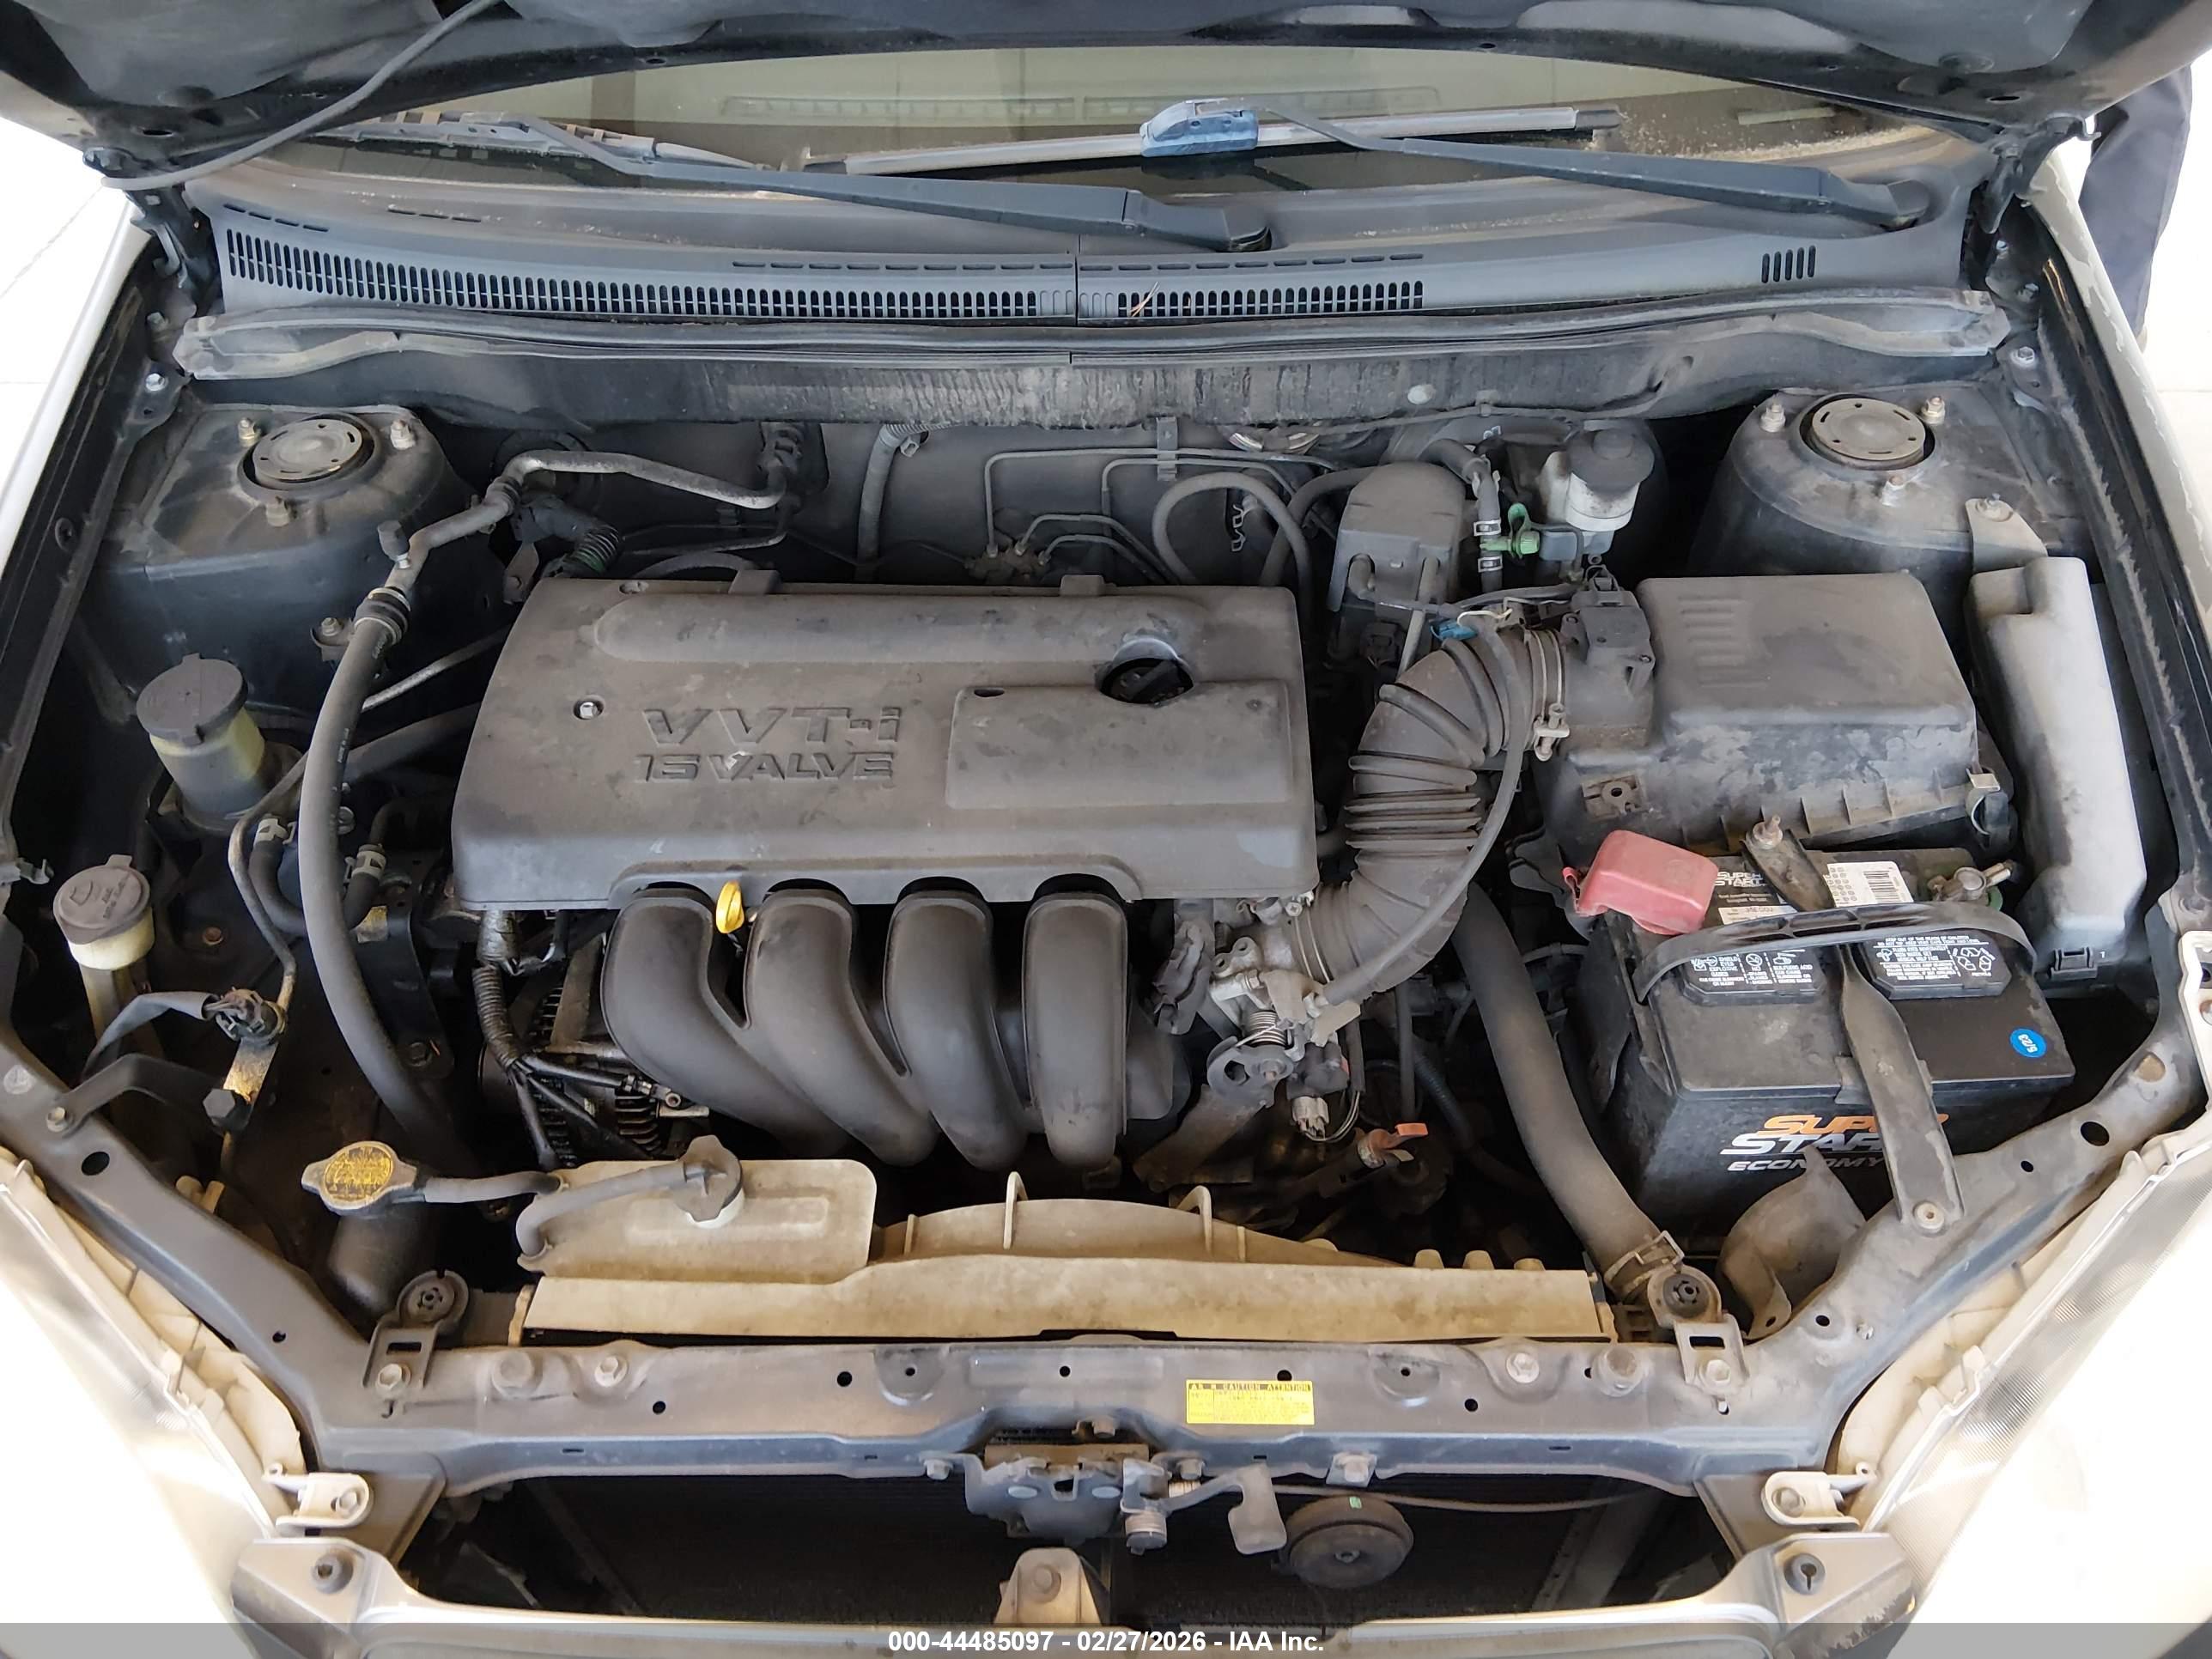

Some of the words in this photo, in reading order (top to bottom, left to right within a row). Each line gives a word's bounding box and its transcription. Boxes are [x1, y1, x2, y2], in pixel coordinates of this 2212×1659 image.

[642, 706, 902, 745] VVT-i
[634, 753, 701, 783] 16
[707, 750, 895, 782] VALVE
[1719, 1133, 1883, 1155] STAR
